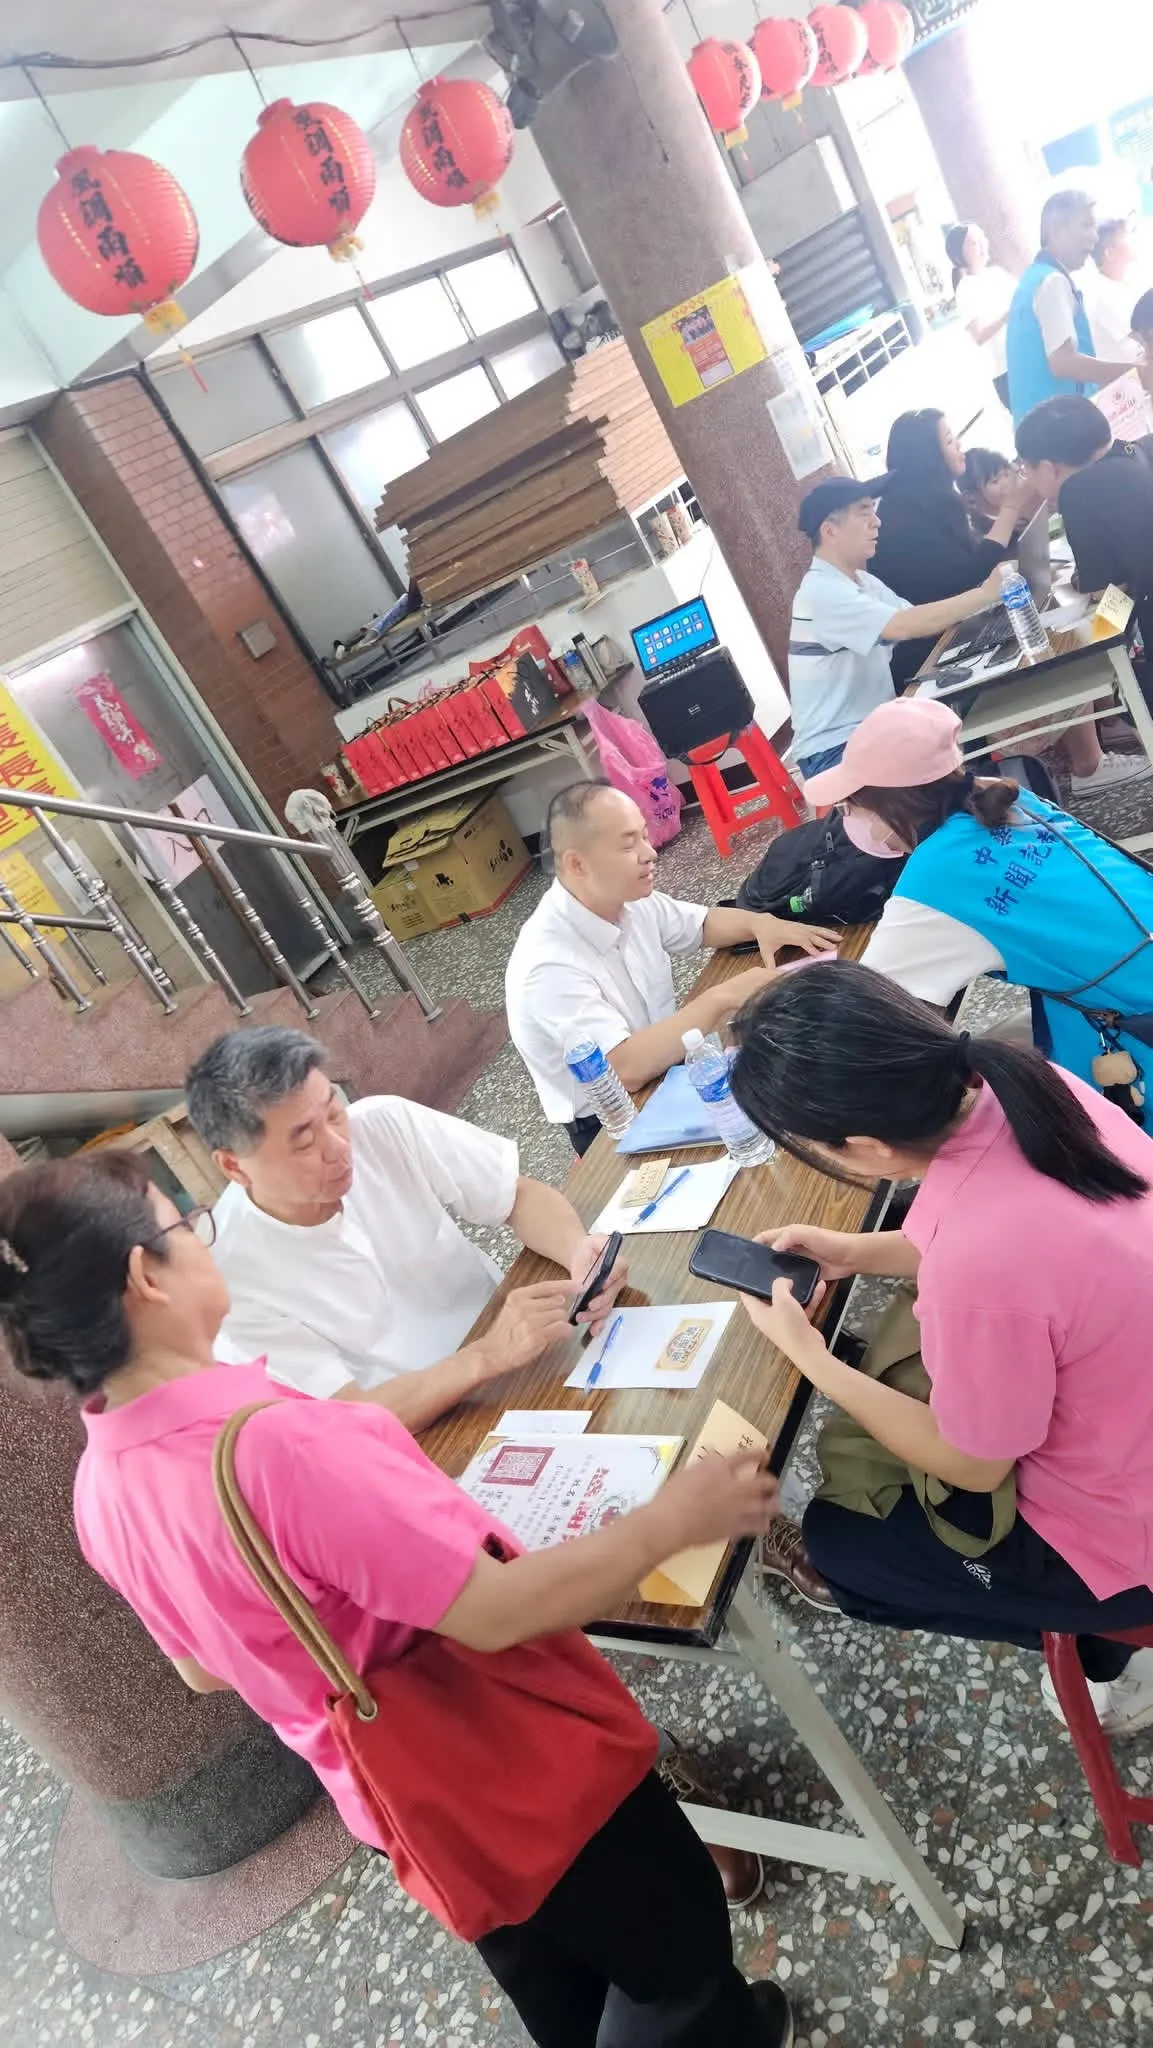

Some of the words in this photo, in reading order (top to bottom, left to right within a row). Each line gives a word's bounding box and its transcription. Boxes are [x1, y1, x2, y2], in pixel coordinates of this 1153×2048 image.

[292, 108, 351, 216] 風調雨順
[420, 100, 469, 189] 風調雨順
[71, 166, 147, 289] 風調雨順
